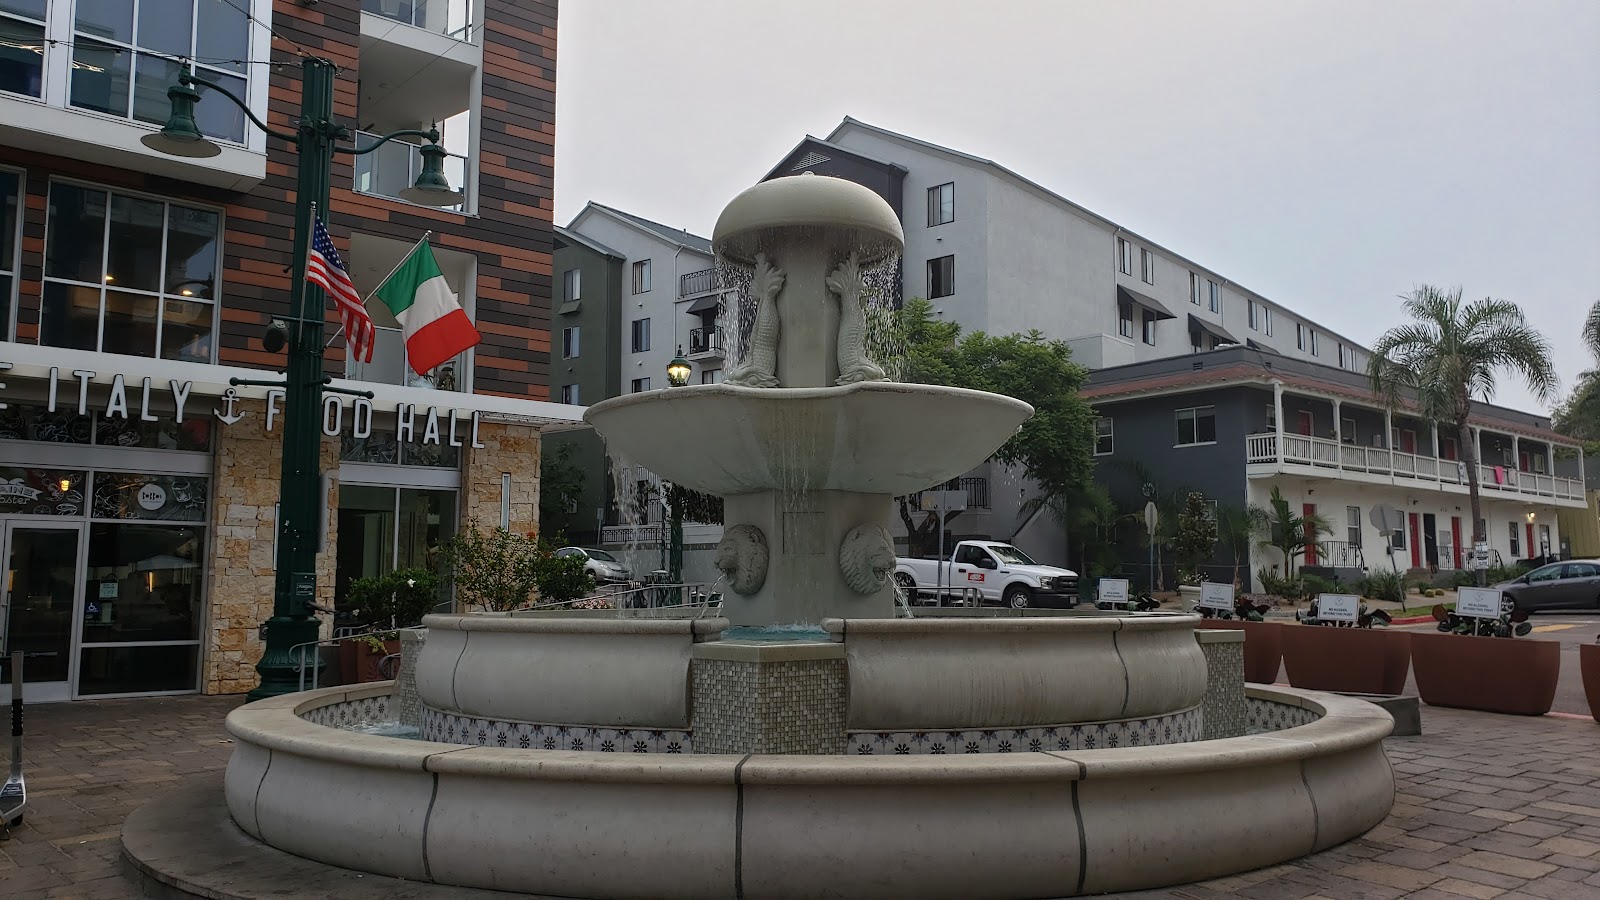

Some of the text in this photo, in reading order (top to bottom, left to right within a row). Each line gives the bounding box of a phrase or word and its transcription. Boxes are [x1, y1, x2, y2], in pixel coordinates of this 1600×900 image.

[47, 366, 194, 424] ITALY
[265, 390, 374, 439] FOD
[397, 403, 485, 449] HALL
